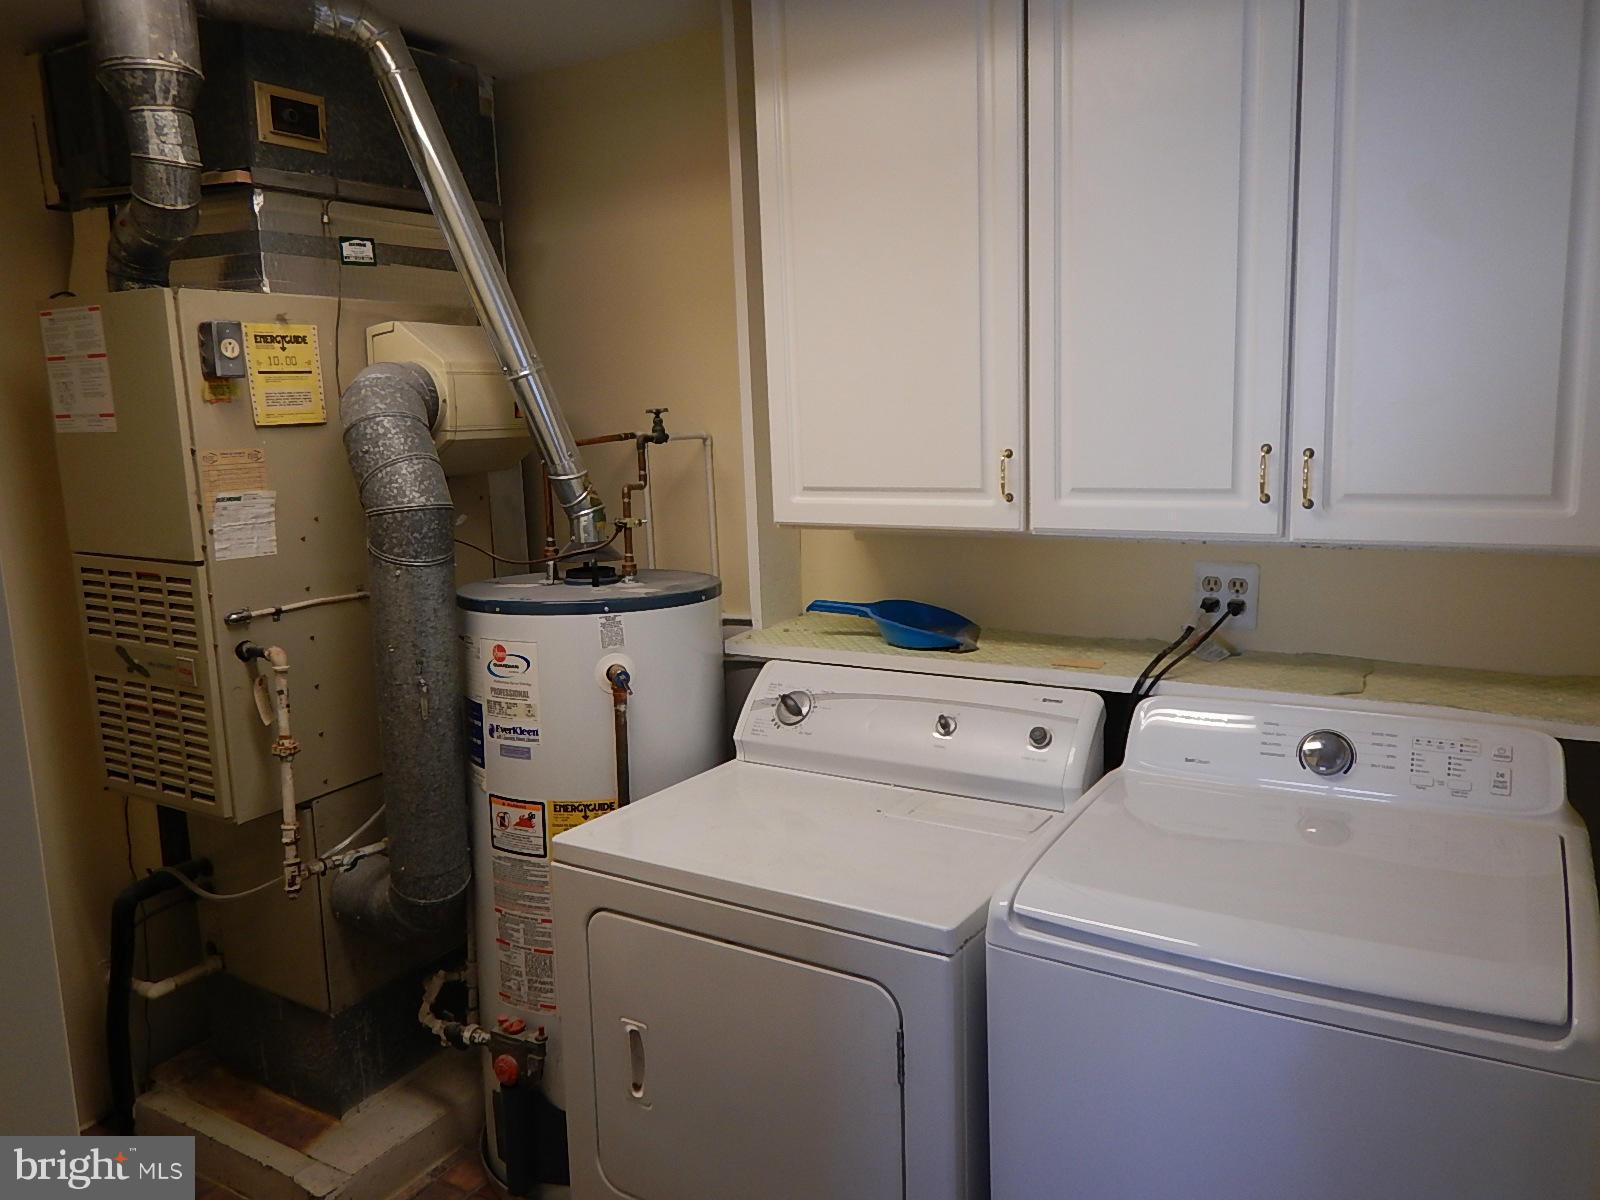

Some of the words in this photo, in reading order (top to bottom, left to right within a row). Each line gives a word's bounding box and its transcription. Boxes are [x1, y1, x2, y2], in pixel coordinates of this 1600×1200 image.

[268, 355, 298, 366] 10.00
[490, 687, 530, 699] PROFESSIONAL
[495, 724, 539, 737] EverKleen
[553, 801, 616, 814] ENERGYGUIDE
